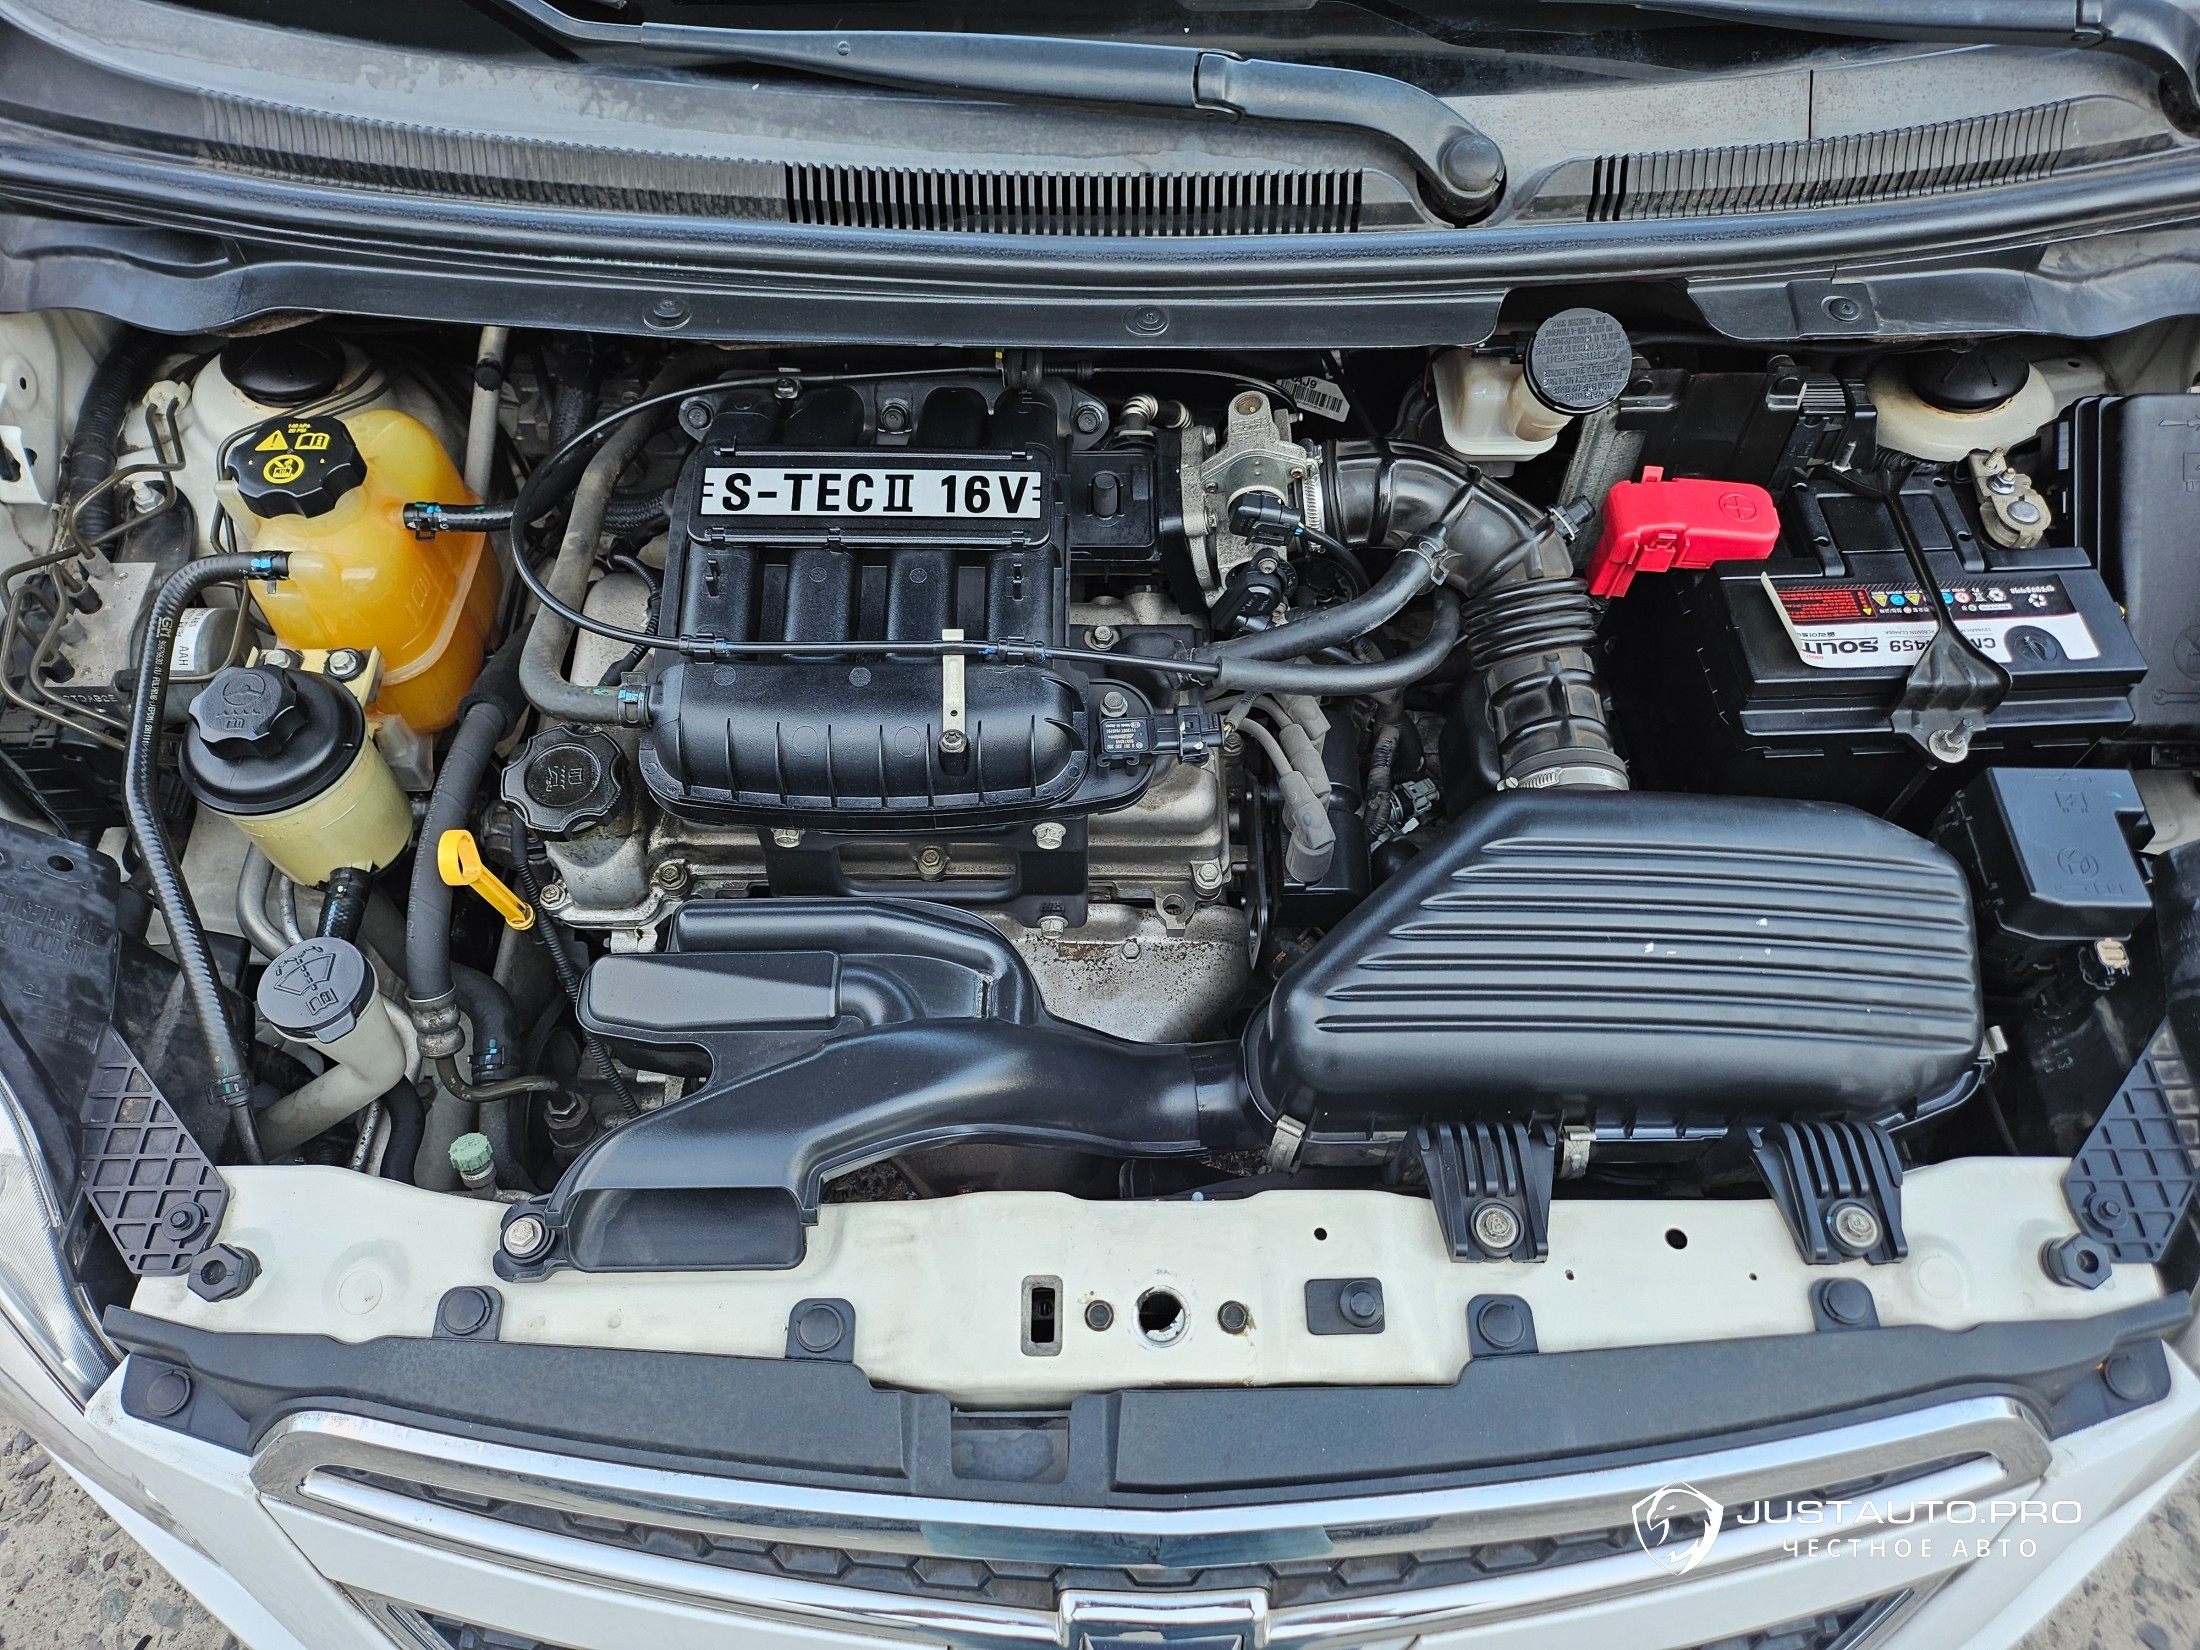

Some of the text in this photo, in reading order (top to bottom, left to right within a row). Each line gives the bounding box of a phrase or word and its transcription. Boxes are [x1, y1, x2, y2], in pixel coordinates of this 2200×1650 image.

[941, 475, 1029, 514] 16V
[178, 646, 189, 666] AAH
[1800, 641, 1879, 655] SOLIT
